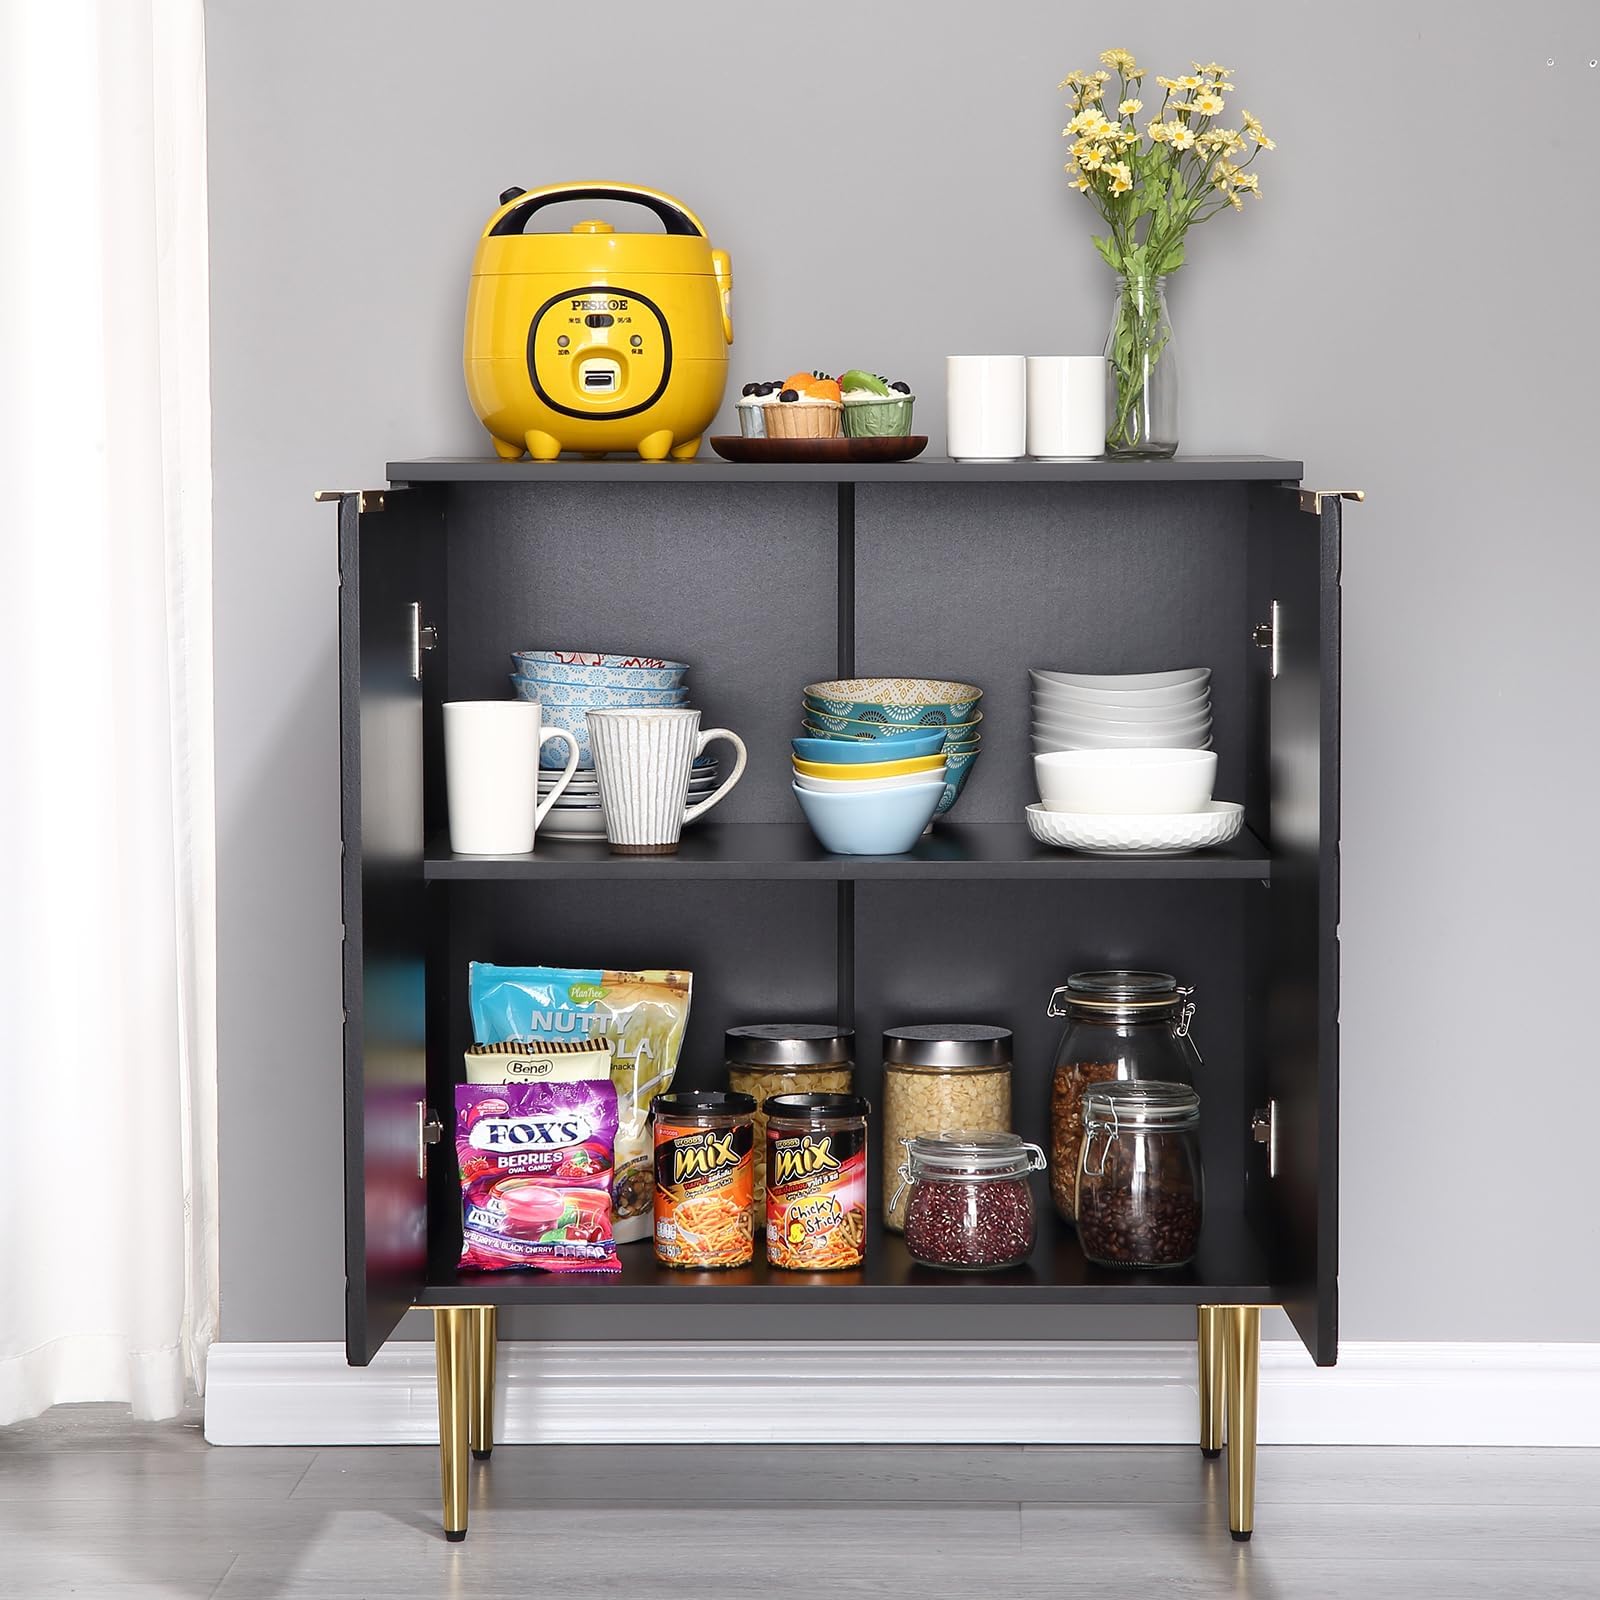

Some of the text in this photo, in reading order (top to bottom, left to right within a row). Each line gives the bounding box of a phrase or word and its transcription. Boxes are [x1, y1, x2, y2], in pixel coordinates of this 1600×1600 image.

[531, 1010, 633, 1034] NUTTY
[486, 1122, 579, 1144] FOX'S
[498, 1152, 563, 1168] BERRIES
[675, 1133, 740, 1182] mix
[776, 1137, 840, 1184] mix
[508, 1164, 553, 1175] OVAL CANDY
[791, 1194, 836, 1221] Chicky
[807, 1211, 844, 1234] Stick
[501, 1243, 524, 1253] BLACK
